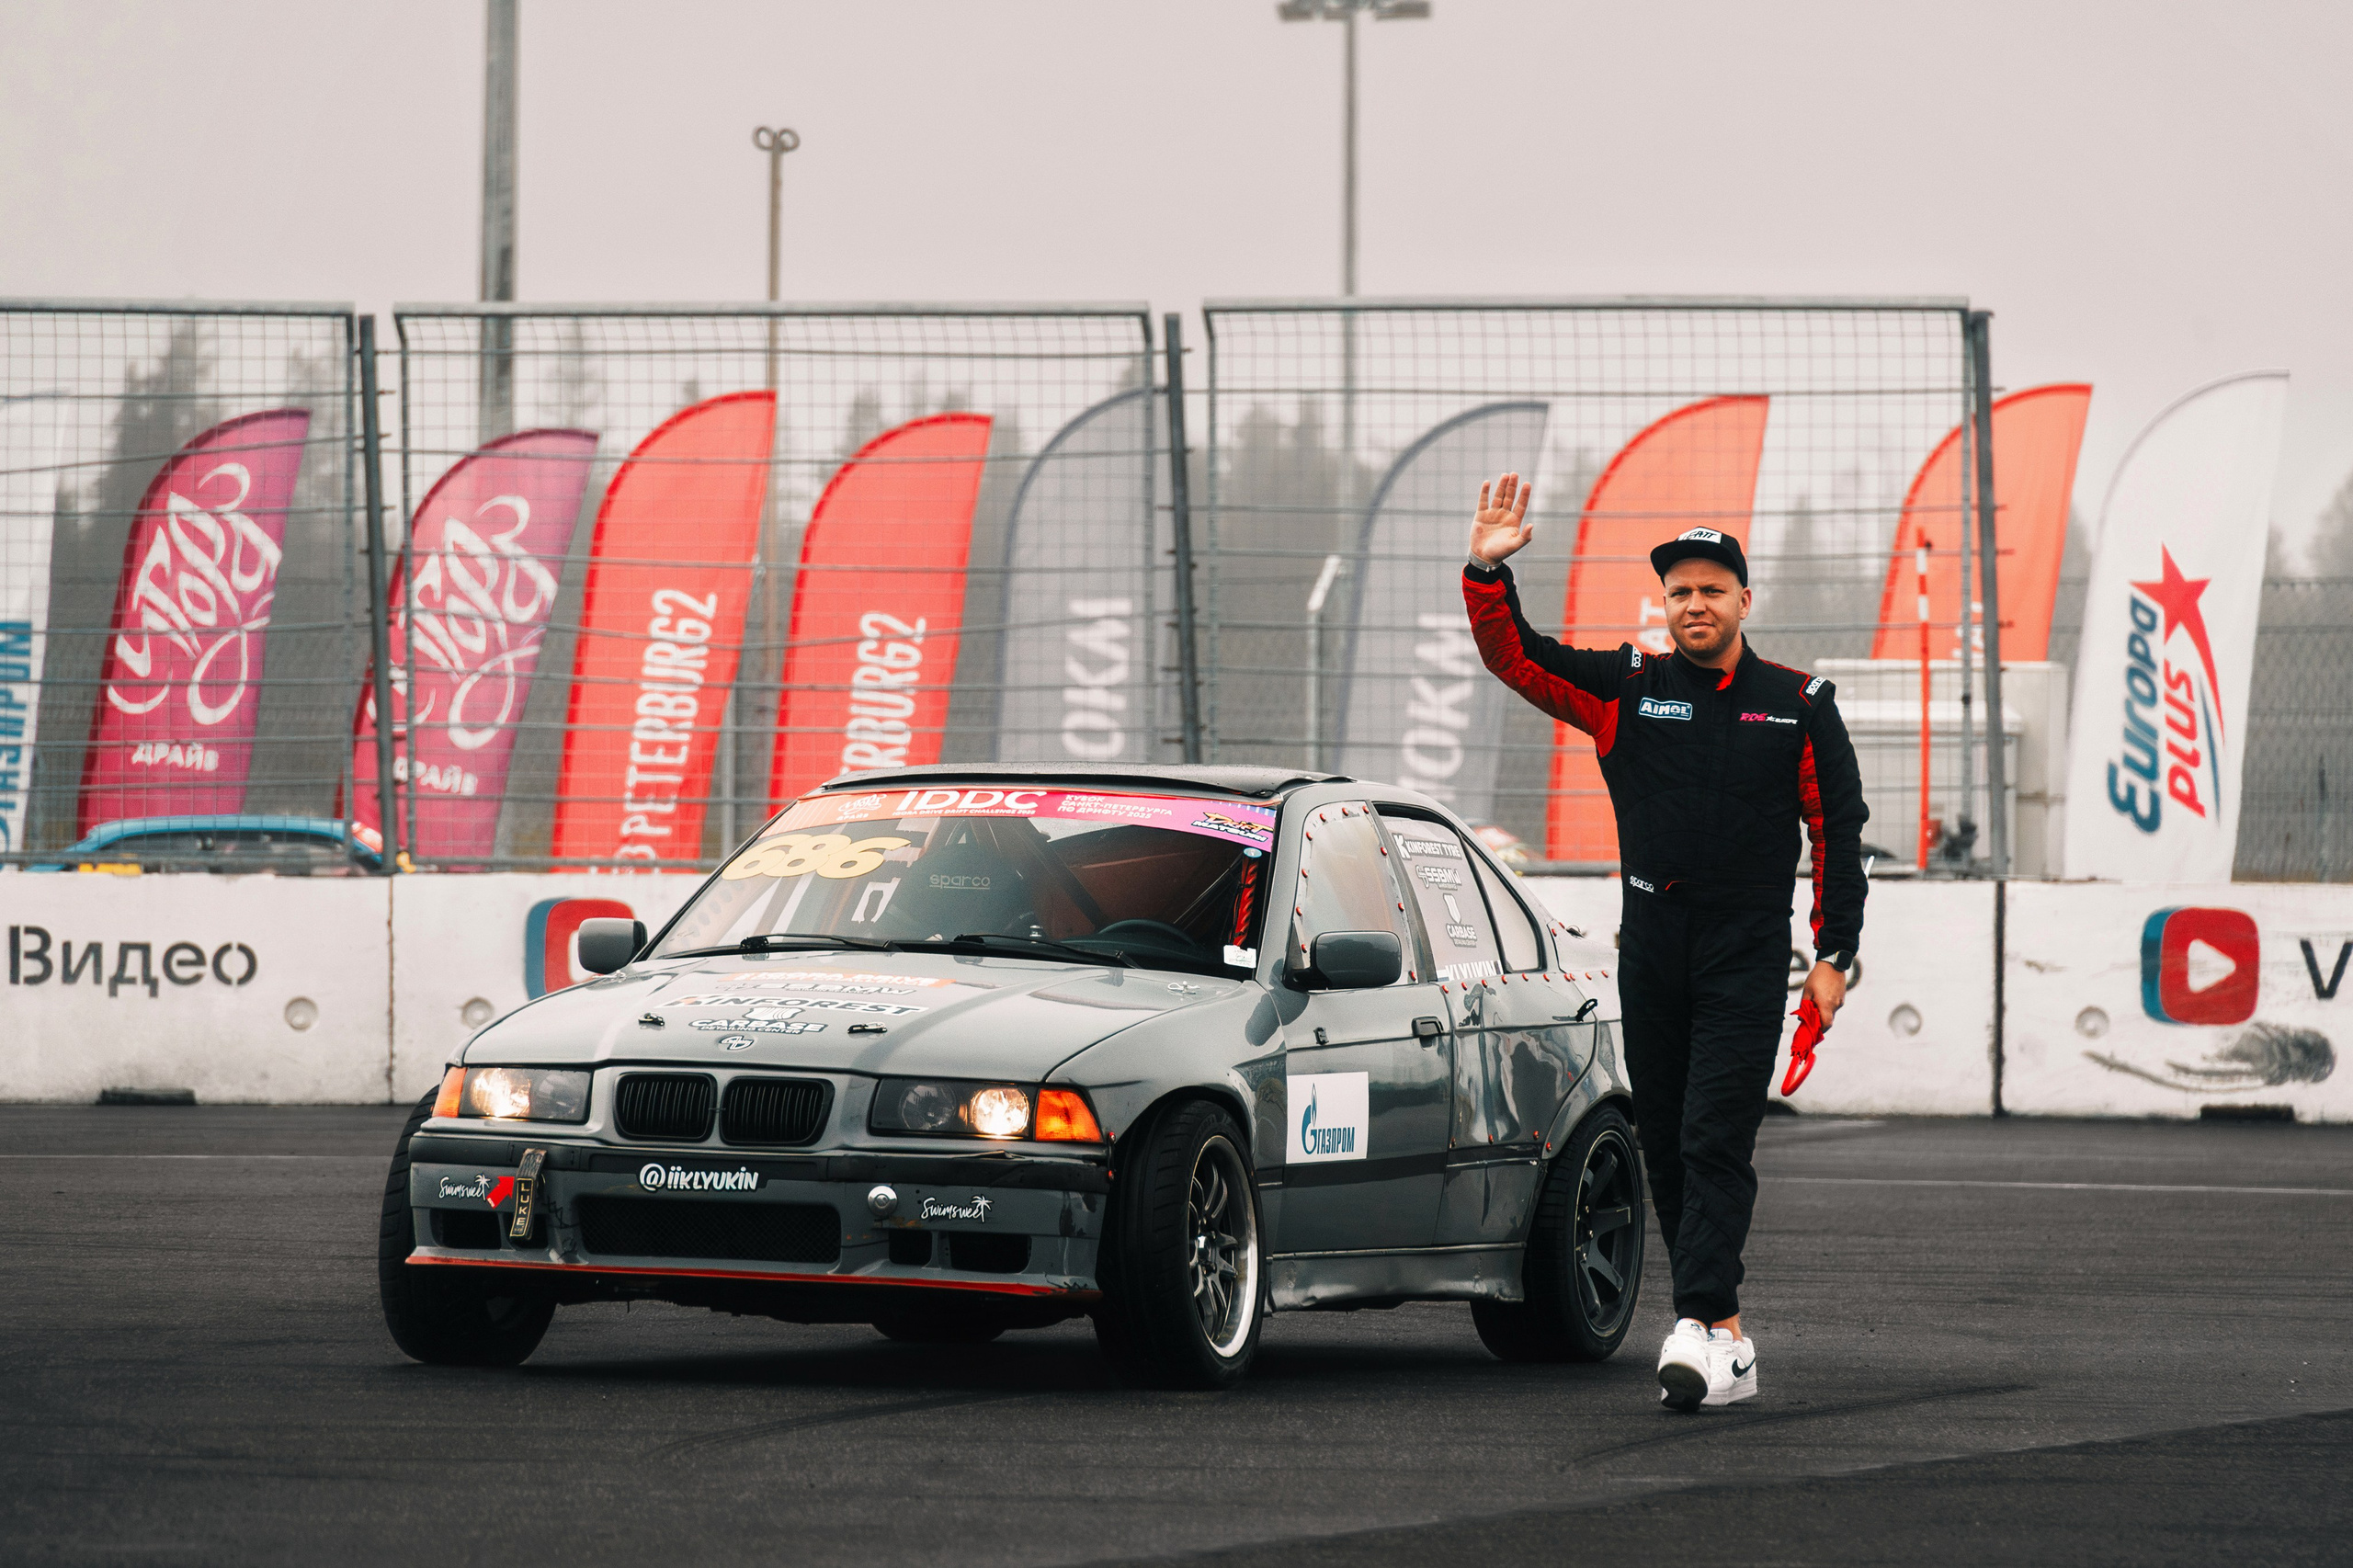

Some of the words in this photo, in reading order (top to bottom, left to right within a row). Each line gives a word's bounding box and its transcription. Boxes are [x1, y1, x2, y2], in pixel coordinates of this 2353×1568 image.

[839, 611, 926, 775] RBURG2
[1641, 700, 1689, 718] AIMOL
[131, 742, 220, 771] ДРАЙВ
[895, 790, 1048, 811] IDDC
[1064, 794, 1106, 803] КУБОК
[1061, 800, 1173, 816] САНКТ-ПЕТЕРБУРГА
[1076, 807, 1127, 816] ДРИФТУ
[722, 834, 912, 881] 686
[1404, 840, 1443, 856] KINFOREST
[1443, 843, 1461, 858] TYRE
[929, 874, 991, 890] sparco
[1447, 924, 1477, 939] CARBASE
[7, 924, 258, 999] Видео
[690, 1019, 826, 1032] CARBASE
[1316, 1127, 1355, 1154] ГАЗПРОМ
[516, 1181, 530, 1226] LUKE
